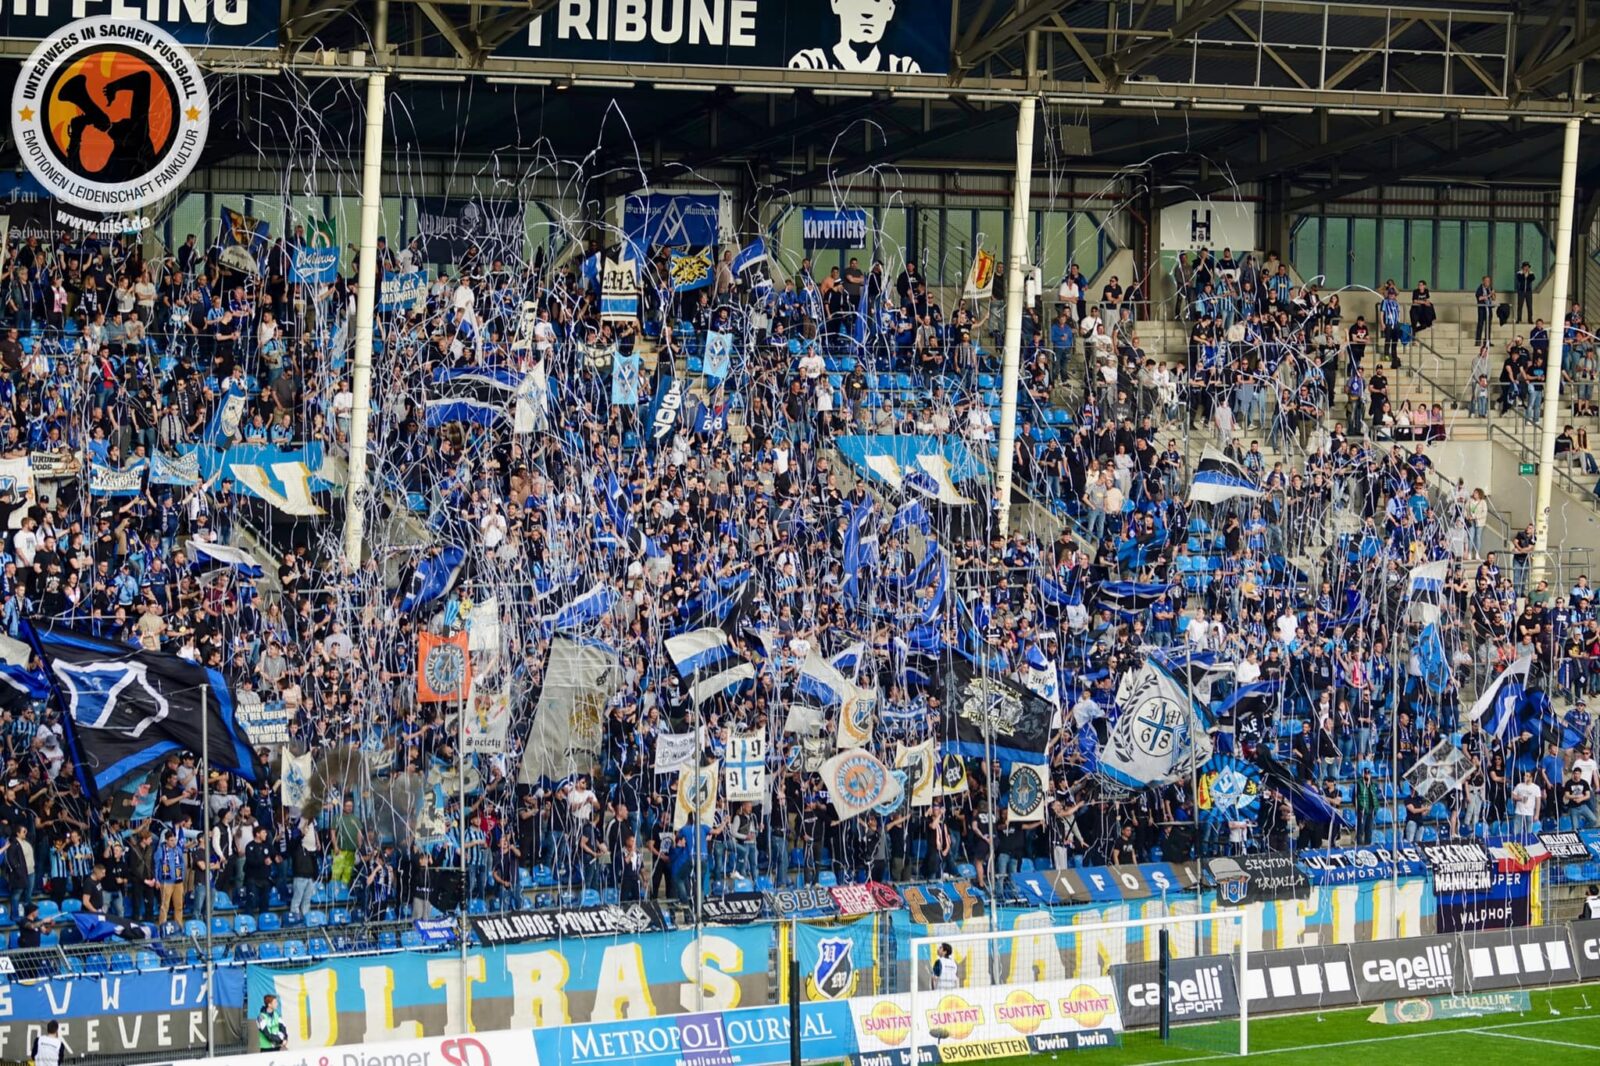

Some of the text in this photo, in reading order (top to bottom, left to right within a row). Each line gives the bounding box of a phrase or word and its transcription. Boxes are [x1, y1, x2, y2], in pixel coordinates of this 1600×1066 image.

[804, 219, 866, 239] KAPUTTICKS
[653, 379, 682, 439] 1907
[1540, 832, 1580, 845] KOLLEKTIV
[1424, 843, 1489, 864] SEKTION
[1435, 870, 1492, 892] MANNHEIM
[1492, 873, 1521, 886] UPER
[1459, 907, 1512, 925] WALDHOF
[1362, 944, 1453, 989] capelli
[1127, 966, 1223, 1010] capelli
[1407, 973, 1453, 991] SPORT
[273, 935, 744, 1048] ULTRAS
[999, 1004, 1046, 1019] SUNTAT
[1062, 998, 1110, 1014] SUNTAT
[1175, 999, 1224, 1016] SPORT
[931, 1009, 979, 1025] SUNTAT
[942, 1039, 1028, 1060] SPORTWETTEN
[1037, 1031, 1108, 1050] bwin bwin
[860, 1053, 892, 1066] bwin
